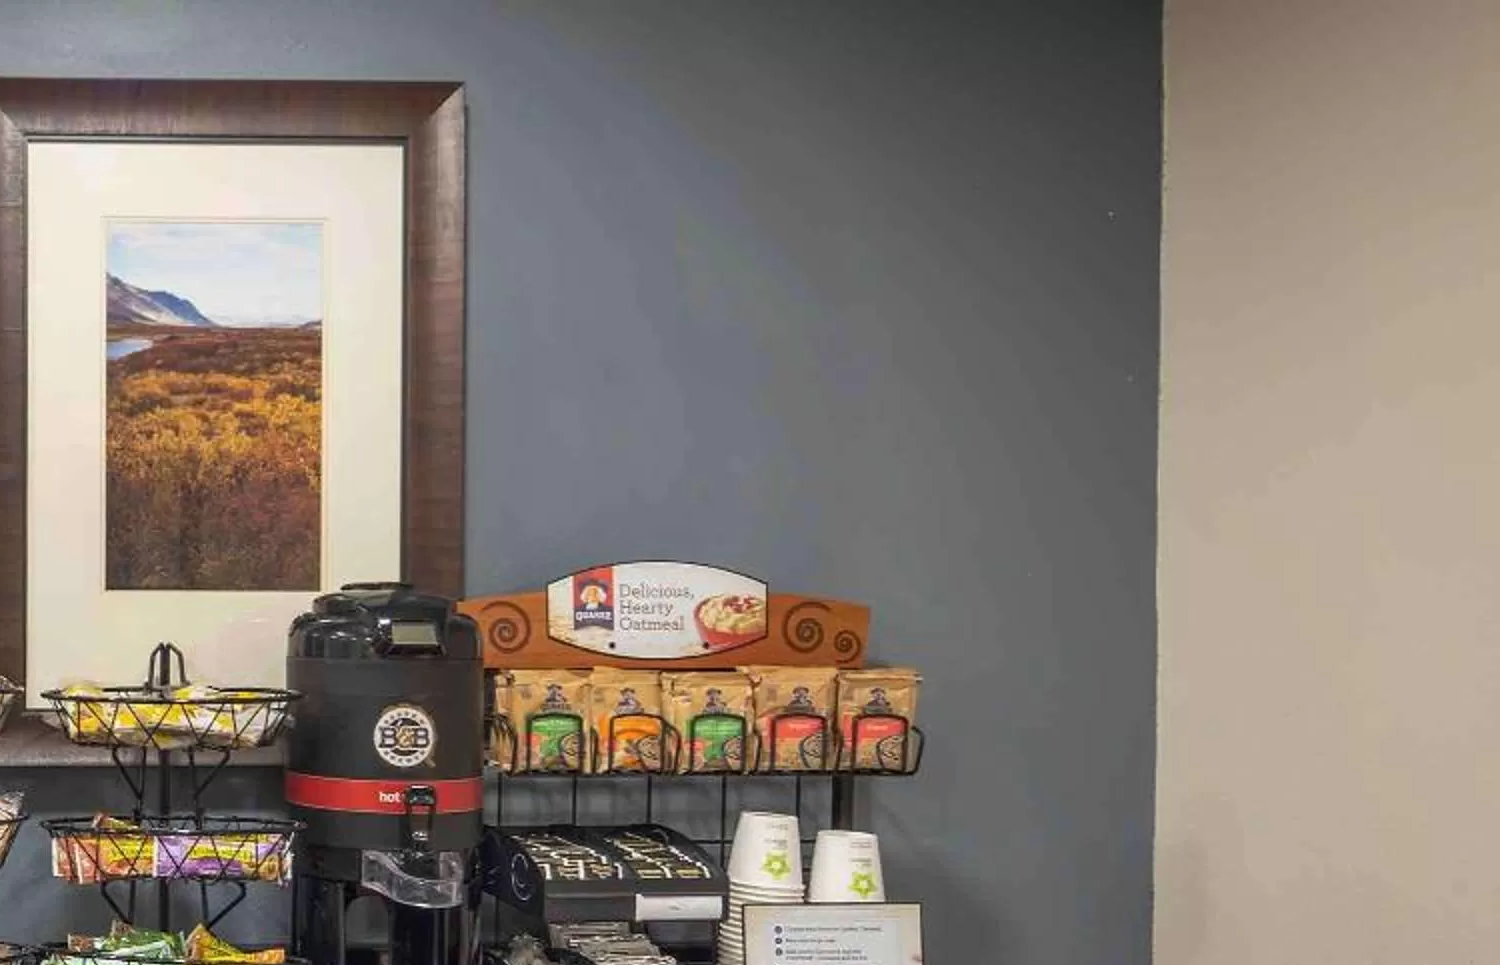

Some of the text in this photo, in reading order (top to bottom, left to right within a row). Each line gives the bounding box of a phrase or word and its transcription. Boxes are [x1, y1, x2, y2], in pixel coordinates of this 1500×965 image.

[618, 581, 695, 600] Delicious,
[619, 600, 674, 616] Hearty
[619, 616, 685, 631] Oatmeal
[379, 791, 401, 803] hot
